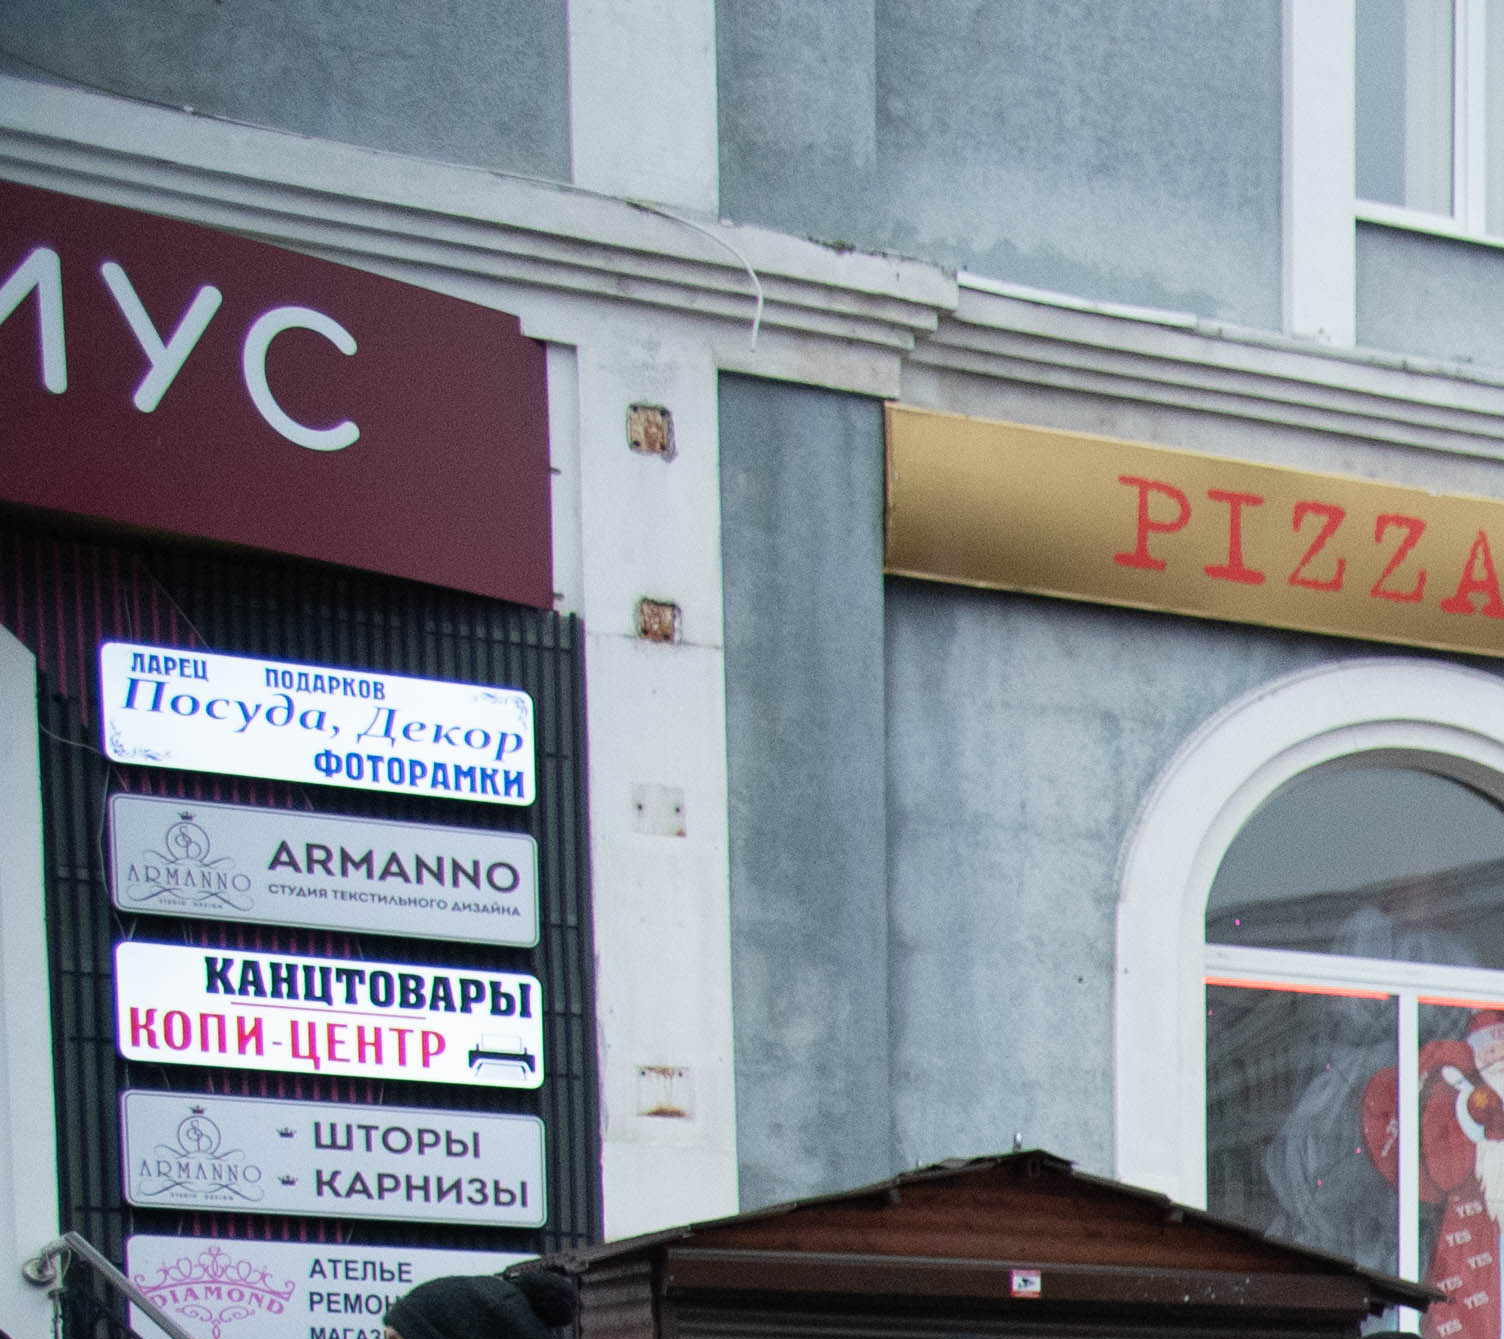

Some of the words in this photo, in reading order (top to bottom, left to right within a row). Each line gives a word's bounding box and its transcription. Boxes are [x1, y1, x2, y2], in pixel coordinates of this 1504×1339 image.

[130, 652, 208, 683] ЛАРЕЦ
[265, 667, 385, 700] ПОДАРКОВ
[123, 677, 341, 737] Посуда,
[356, 705, 524, 761] Декор
[314, 749, 525, 798] ФОТОРАМКИ
[128, 863, 252, 892] ARMANNO
[268, 840, 520, 894] ARMANNO
[267, 882, 328, 902] СТУДИЯ
[332, 887, 447, 911] ТЕКСТИЛЬНОГО
[451, 897, 521, 918] ДИЗАЙНА
[205, 956, 532, 1018] КАНЦТОВАРЫ
[129, 1006, 446, 1069] КОПИ-ЦЕНТР
[314, 1121, 481, 1159] ШТОРЫ
[139, 1159, 262, 1183] ARMANNO
[315, 1169, 528, 1208] КАРНИЗЫ
[1456, 1200, 1483, 1218] YES
[1445, 1228, 1471, 1247] YES
[309, 1258, 412, 1283] АТЕЛЬЕ
[1467, 1252, 1493, 1270] YES
[1437, 1275, 1463, 1292] YES
[149, 1284, 284, 1315] DIAMOND
[1464, 1291, 1489, 1309] YES
[1437, 1319, 1462, 1337] YES
